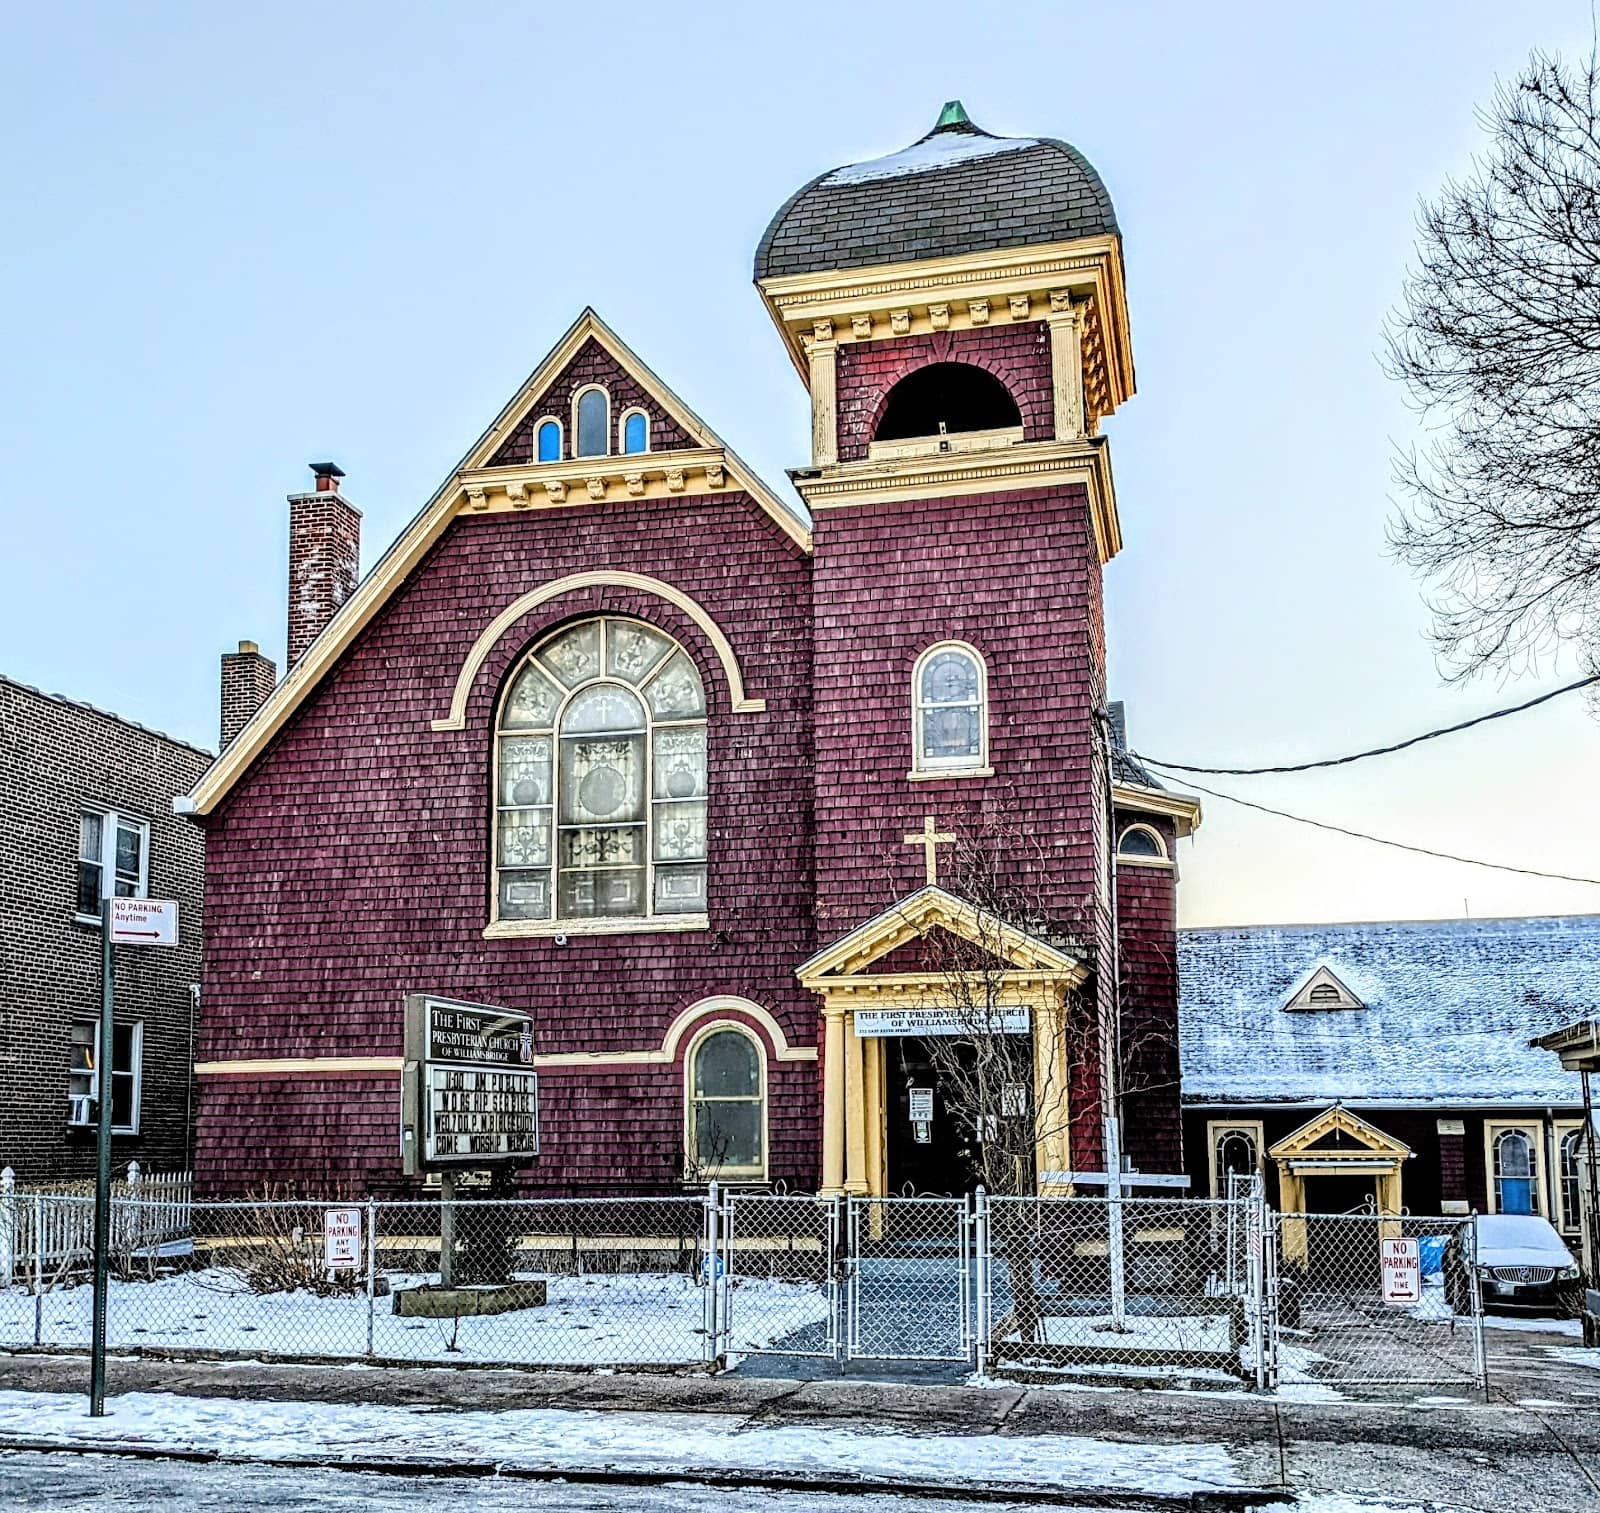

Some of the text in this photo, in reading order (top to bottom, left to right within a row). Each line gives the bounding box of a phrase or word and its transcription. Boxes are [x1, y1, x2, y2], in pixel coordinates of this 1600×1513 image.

[115, 902, 163, 913] NO PARKING
[115, 912, 147, 923] Anytime
[431, 1010, 481, 1031] THE FIRST
[859, 1012, 878, 1020] THE
[880, 1011, 906, 1019] FIRST
[891, 1019, 904, 1027] OF
[432, 1030, 519, 1051] PRESBYTERIAN CHURCH
[442, 1047, 509, 1061] OF WILLIAMSBRIDGE
[442, 1092, 487, 1111] WORSHIP
[436, 1135, 458, 1153] COME
[469, 1135, 501, 1152] WORSHIP
[336, 1213, 349, 1224] NO
[328, 1226, 358, 1237] PARKING
[335, 1247, 350, 1255] TIME
[1393, 1242, 1407, 1254] NO
[1384, 1257, 1417, 1269] PARKING
[1394, 1271, 1407, 1279] ANY
[1393, 1281, 1409, 1289] TIME
